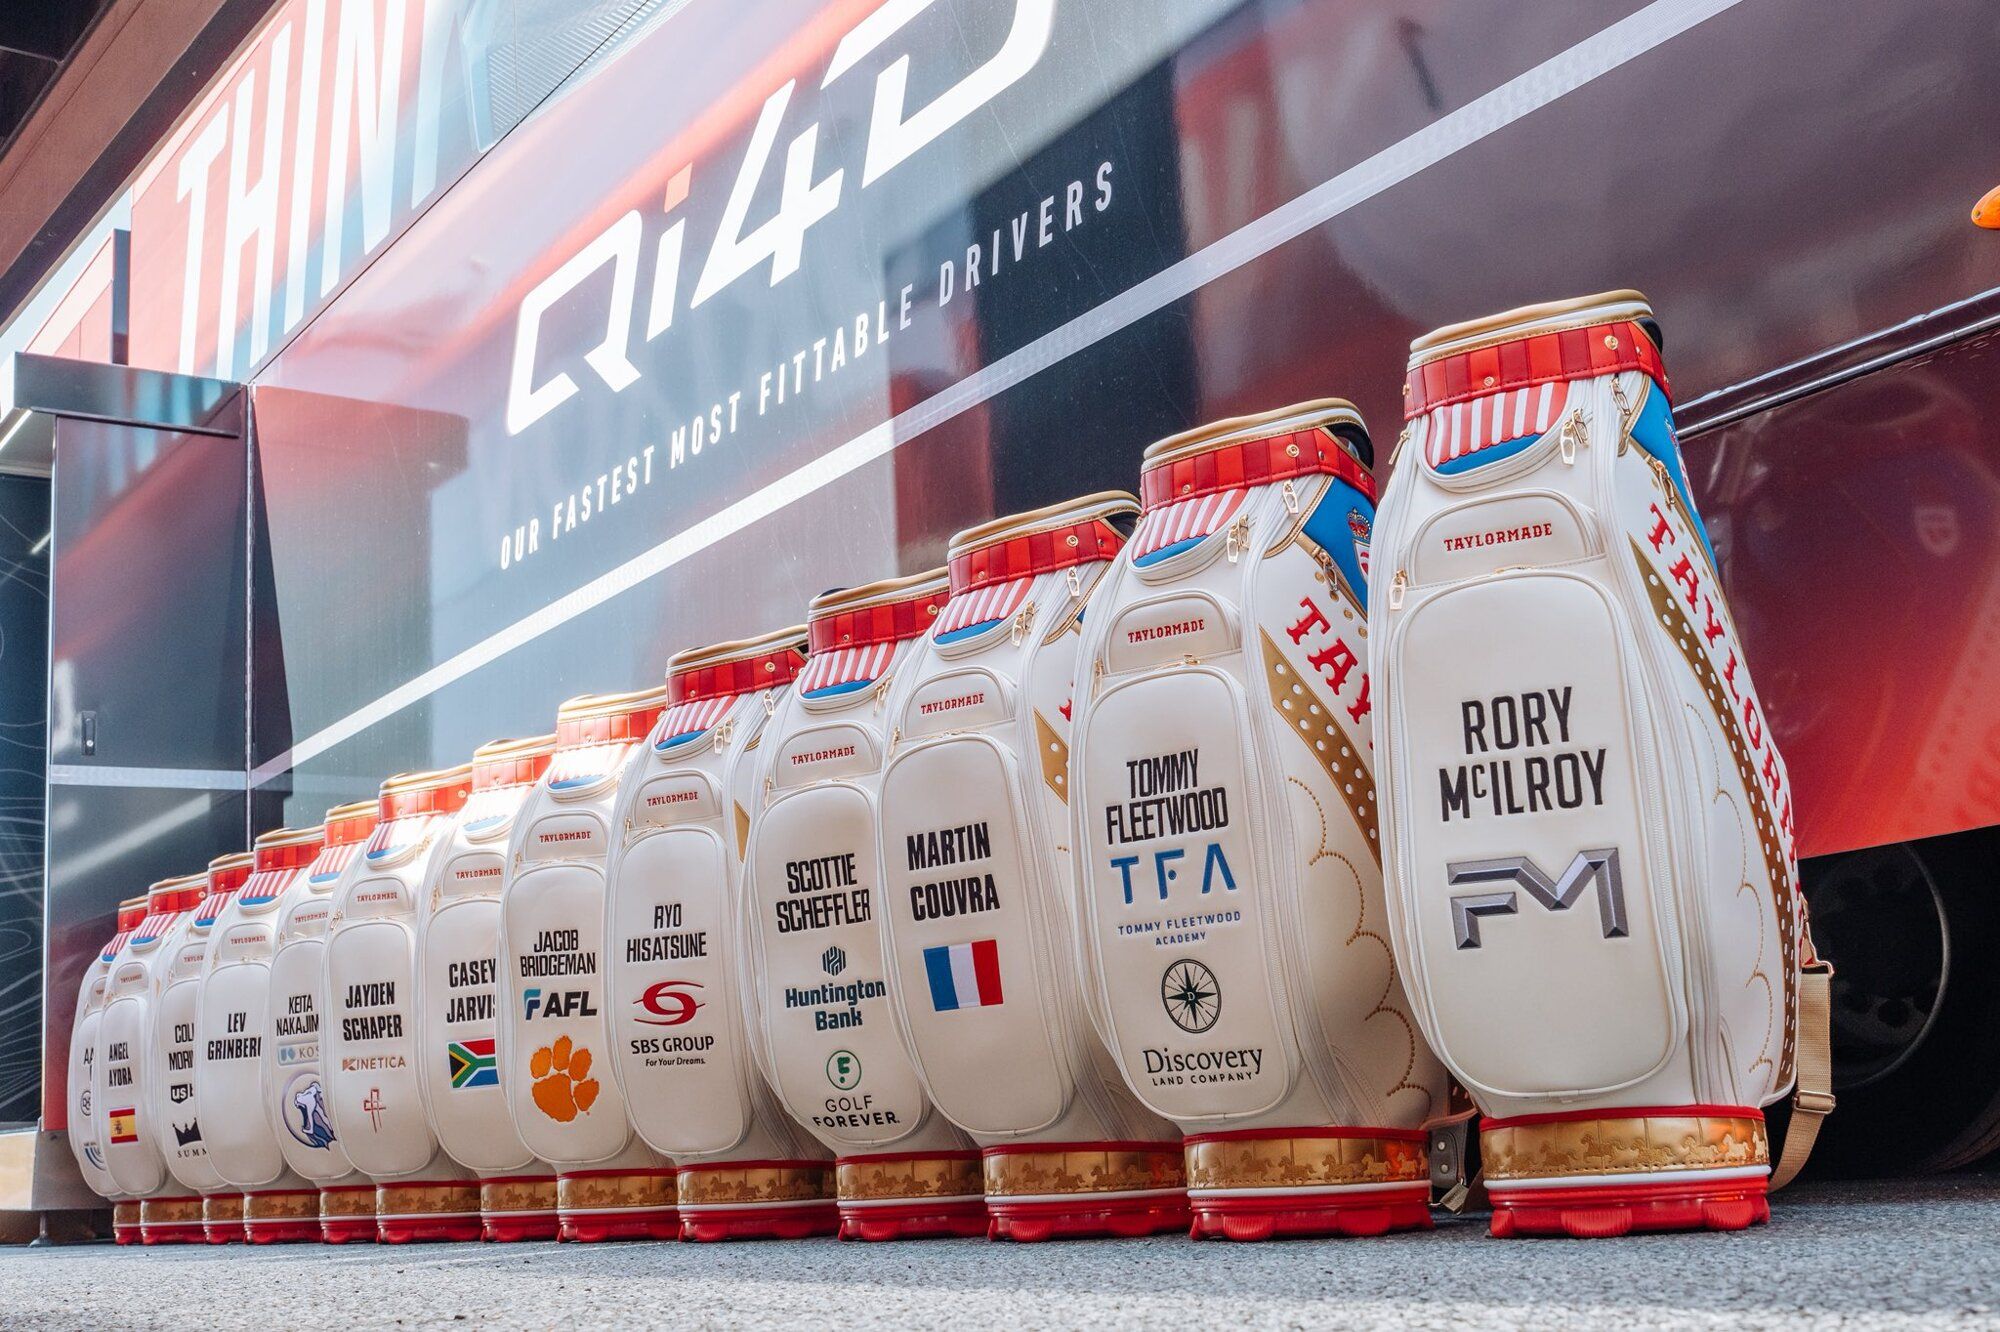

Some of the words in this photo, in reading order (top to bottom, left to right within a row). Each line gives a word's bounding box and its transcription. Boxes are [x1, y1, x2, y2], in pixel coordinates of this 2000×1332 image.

[501, 518, 539, 570] OUR
[553, 445, 654, 540] FASTEST
[670, 391, 741, 469] MOST
[759, 283, 913, 416] FITTABLE
[939, 161, 1113, 308] DRIVERS
[1444, 523, 1553, 552] TAYLORMADE
[1128, 619, 1204, 643] TAYLORMADE
[921, 693, 985, 714] TAYLORMADE
[1461, 686, 1572, 755] RORY
[792, 746, 855, 765] TAYLORMADE
[1126, 748, 1198, 799] TOMMY
[647, 791, 698, 806] TAYLORMADE
[1106, 786, 1229, 845] FLEETWOOD
[540, 831, 591, 843] TAYLORMADE
[906, 821, 991, 871] MARTIN
[456, 868, 501, 880] TAYLORMADE
[786, 853, 857, 894] SCOTTIE
[357, 892, 398, 902] TAYLORMADE
[910, 874, 1000, 922] COUVRA
[654, 903, 681, 929] RYO
[776, 889, 871, 933] SCHEFFLER
[1118, 921, 1161, 935] TOMMY
[1167, 911, 1241, 930] FLEETWOOD
[534, 929, 579, 953] JACOB
[626, 932, 707, 962] HISATSUNE
[1155, 932, 1206, 946] ACADEMY
[449, 958, 496, 988] CASEY
[520, 952, 596, 977] BRIDGEMAN
[288, 993, 313, 1014] KEITA
[345, 981, 395, 1009] JAYDEN
[785, 980, 886, 1008] Huntington
[228, 1012, 246, 1033] LEV
[342, 1014, 402, 1042] SCHAPER
[815, 1007, 863, 1031] Bank
[109, 1042, 129, 1061] ANGEL
[631, 1038, 659, 1054] SBS
[662, 1036, 714, 1052] GROUP
[342, 1056, 406, 1071] KINETICA
[645, 1057, 657, 1067] For
[659, 1057, 675, 1067] Your
[1143, 1047, 1263, 1075] Discovery
[109, 1067, 133, 1087] AYORA
[1152, 1076, 1184, 1087] LAND
[1191, 1072, 1253, 1084] COMPANY
[825, 1095, 873, 1113] GOLF
